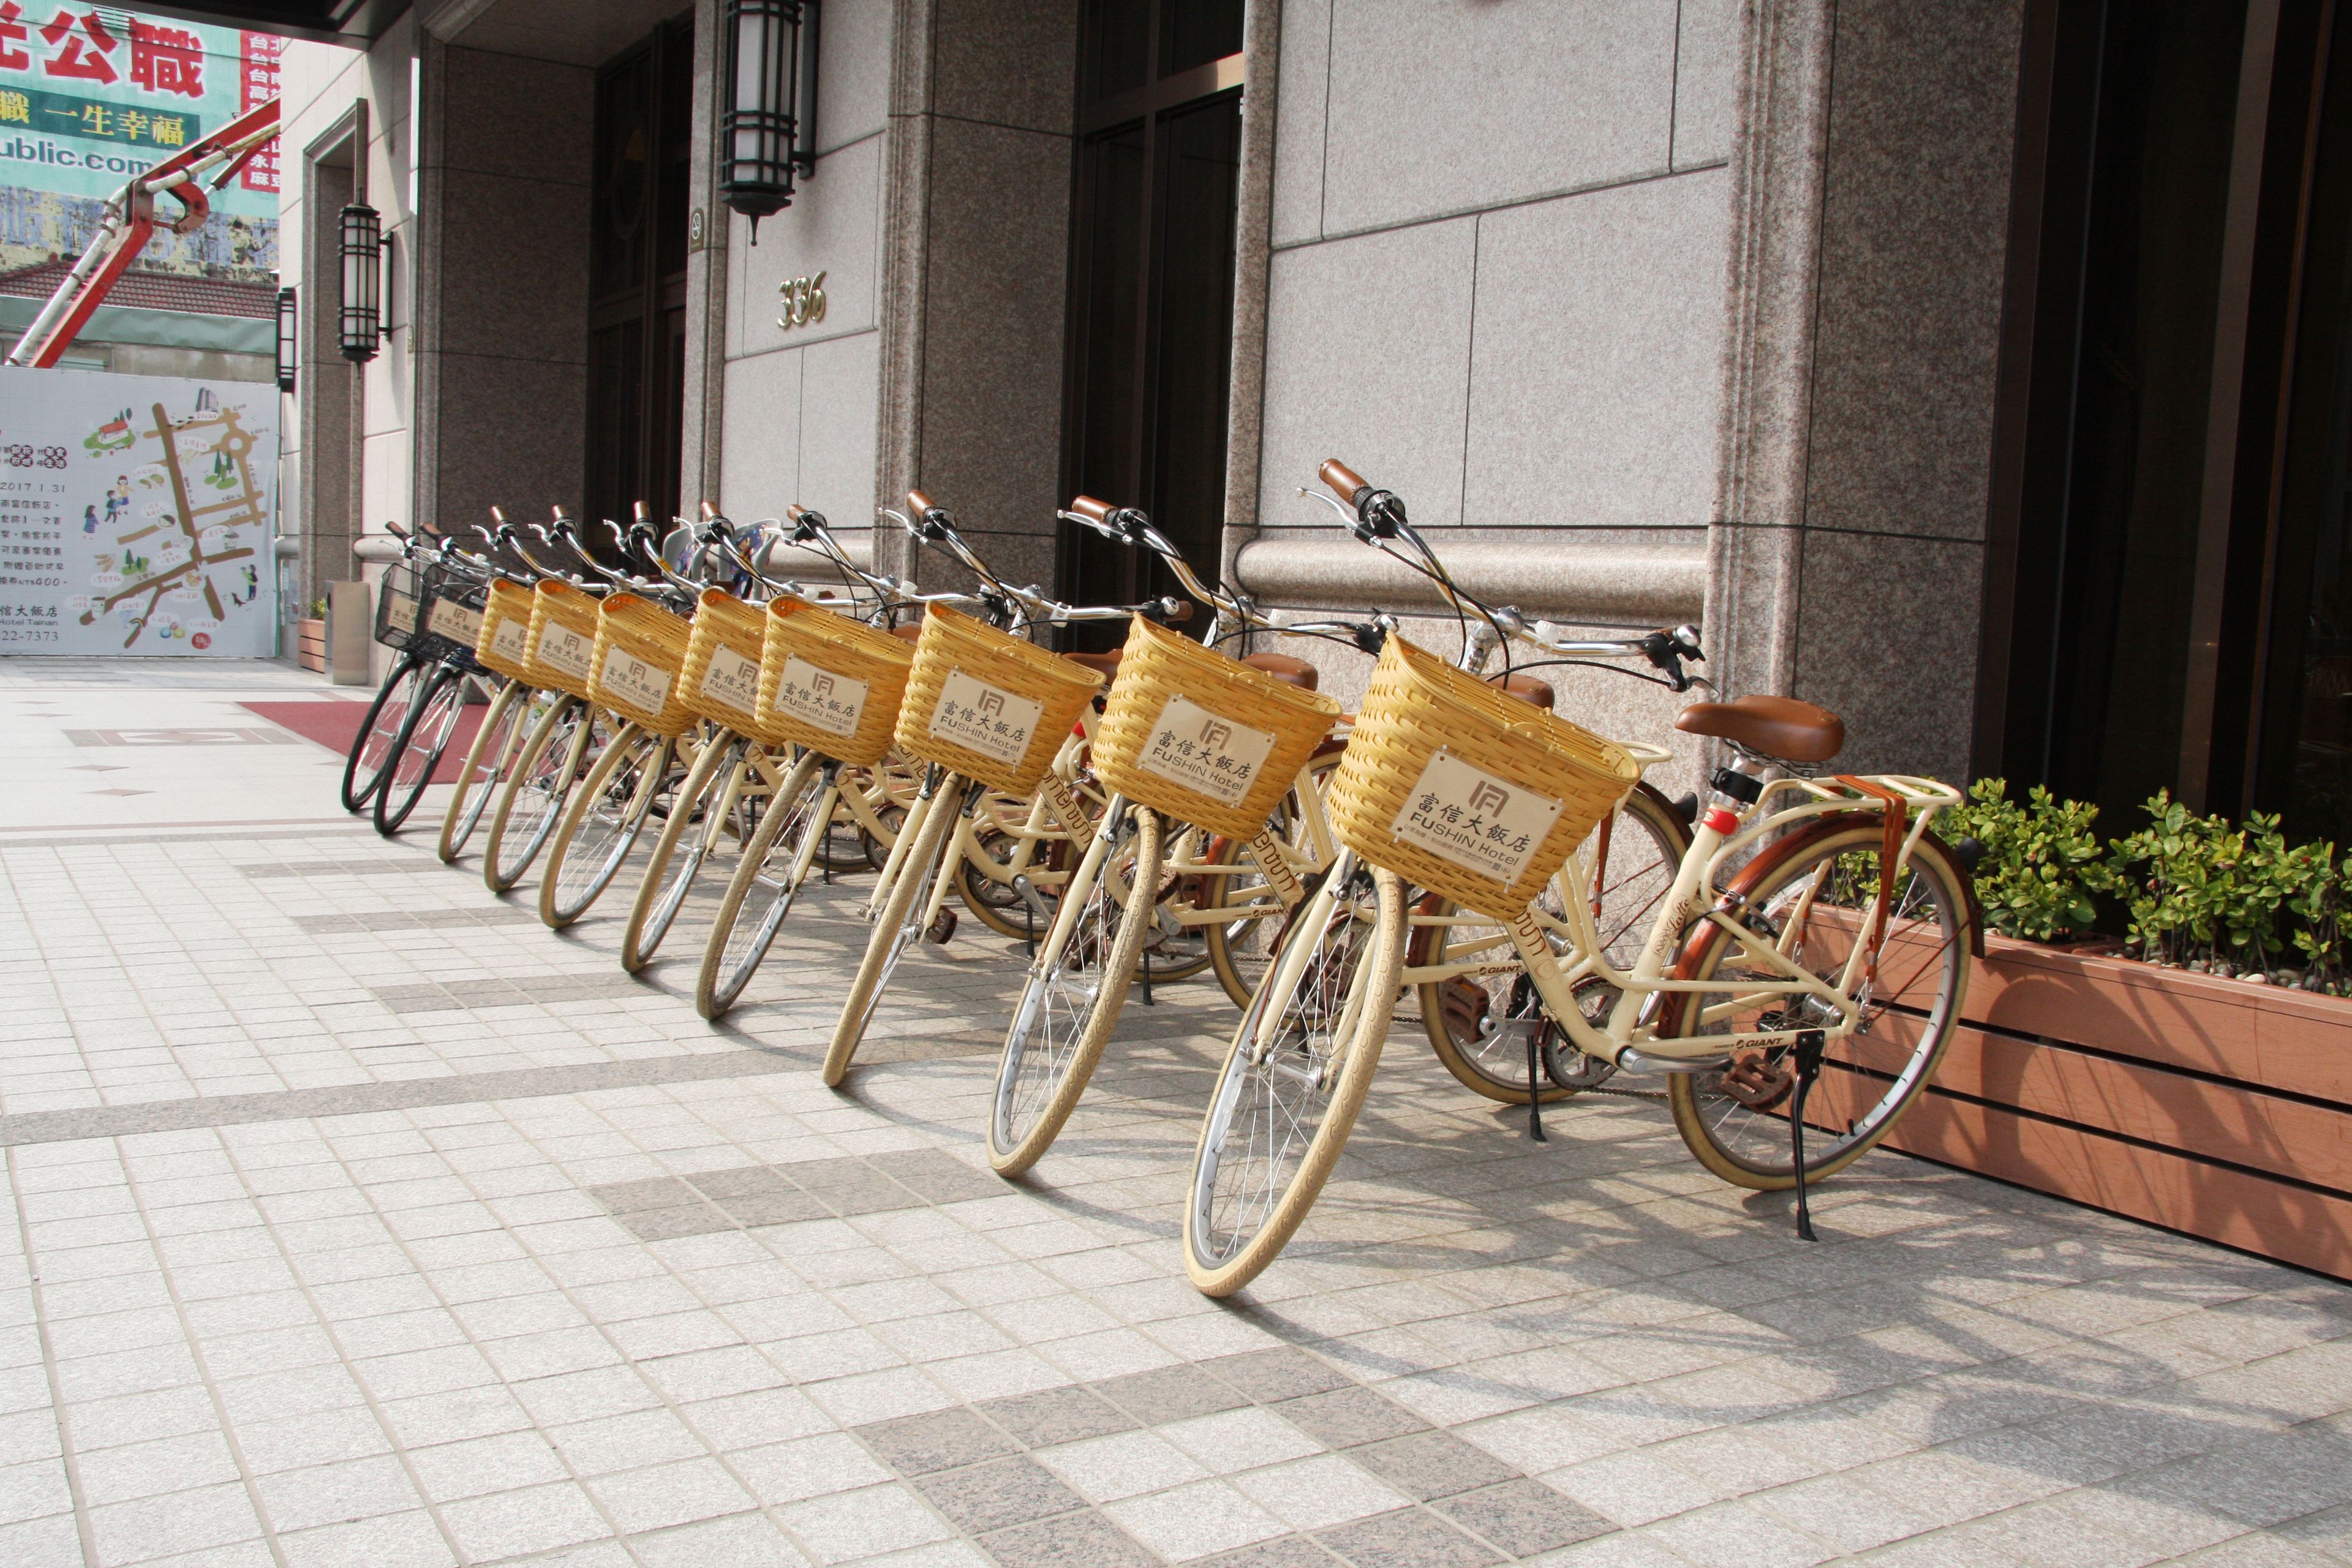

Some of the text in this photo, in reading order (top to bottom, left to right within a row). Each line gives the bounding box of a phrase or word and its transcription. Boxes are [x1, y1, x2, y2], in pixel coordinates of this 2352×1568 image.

[45, 105, 184, 146] 一生幸福
[778, 271, 827, 330] 336
[0, 604, 58, 617] 信大飯店
[606, 676, 637, 696] FUSHIN
[638, 693, 660, 706] Hotel
[608, 666, 661, 698] 富信大飯店
[709, 679, 745, 701] FUSHIN
[785, 681, 856, 717] 富信大飯店
[783, 695, 823, 717] FUSHIN
[826, 712, 853, 726] Hotel
[944, 700, 1026, 742] 富信大飯店
[940, 715, 988, 741] FUSHIN
[990, 736, 1020, 753] Hotel
[1152, 747, 1208, 777] FUSHIN
[1209, 771, 1244, 791] Hotel
[1159, 729, 1252, 780] 富信大飯店
[1409, 812, 1476, 849] FUSHIN
[1479, 842, 1520, 867] Hotel
[1419, 792, 1531, 853] 富信大飯店
[1253, 827, 1295, 892] entum
[1488, 965, 1521, 974] GIANT
[1746, 1038, 1783, 1047] GIANT
